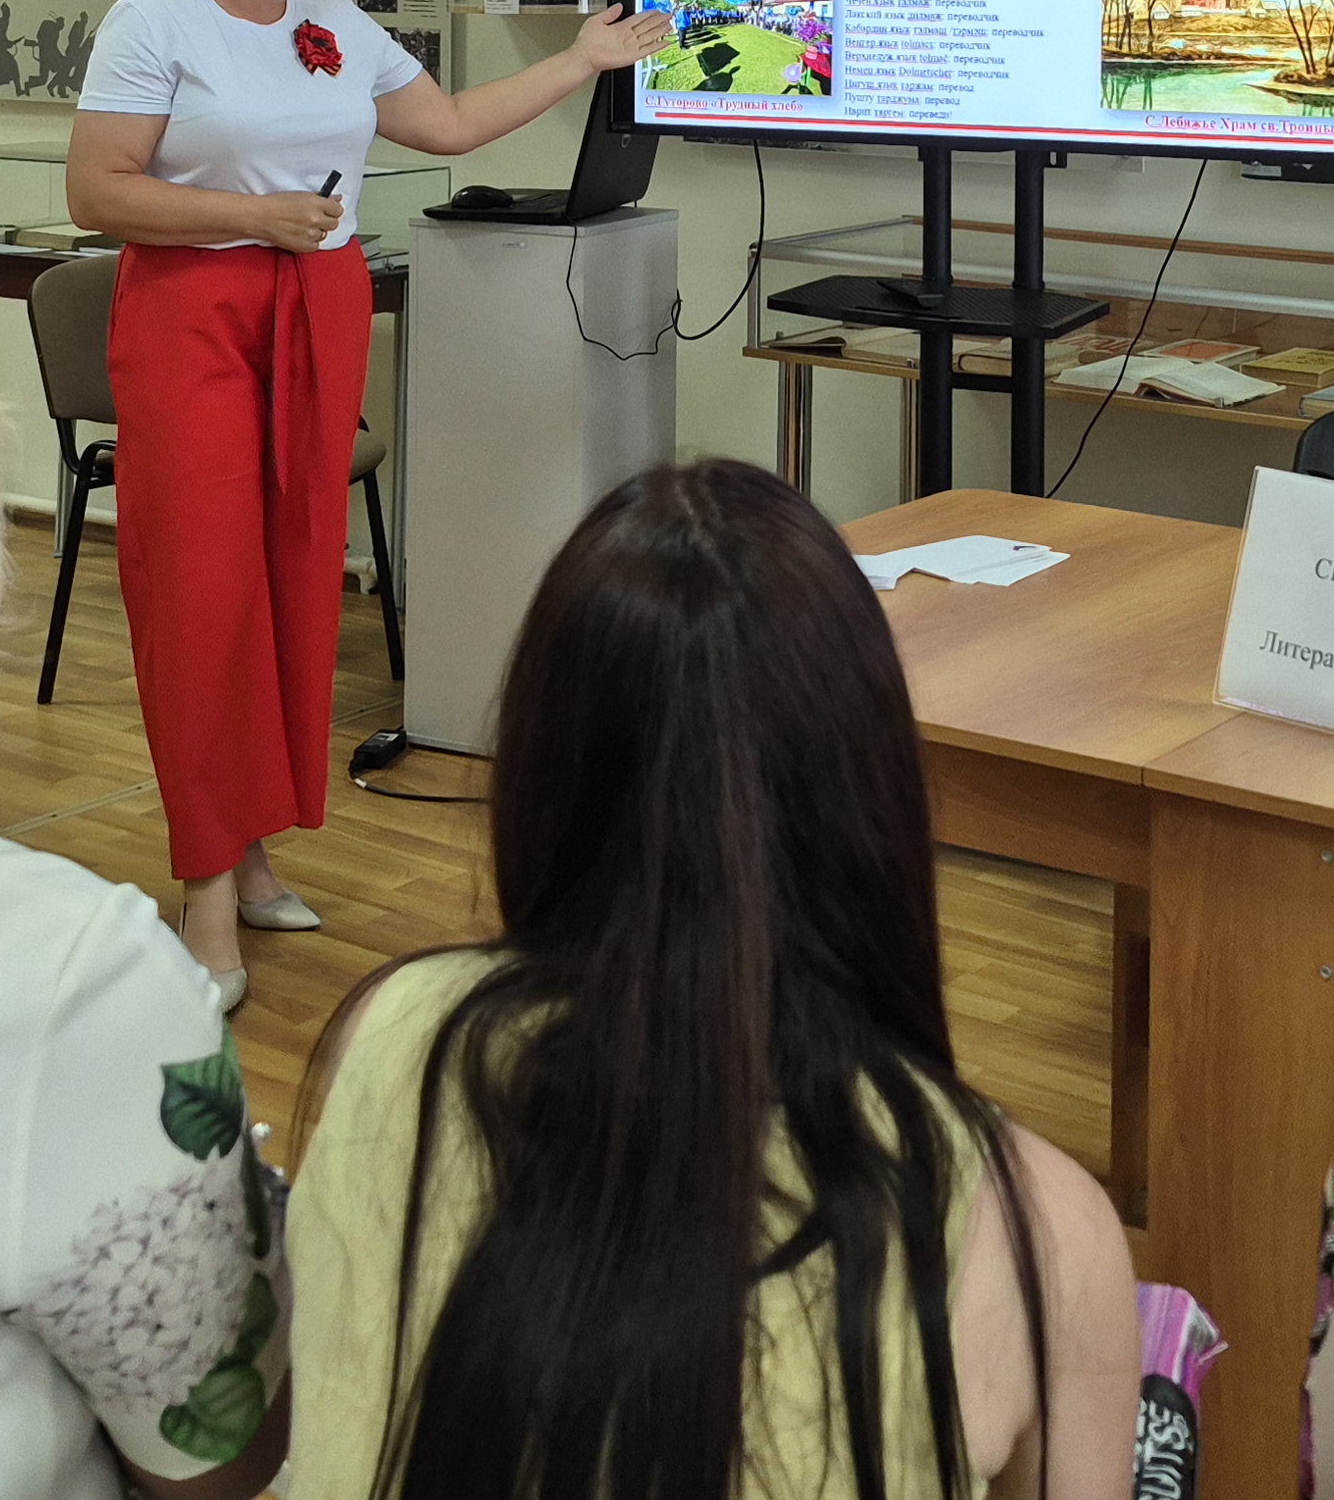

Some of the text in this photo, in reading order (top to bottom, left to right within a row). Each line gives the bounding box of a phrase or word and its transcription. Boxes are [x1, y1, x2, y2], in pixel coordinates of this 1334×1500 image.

[935, 0, 987, 10] переводчик
[845, 9, 882, 20] Лакский
[884, 12, 906, 20] язык
[947, 13, 1000, 24] переводчик
[991, 28, 1045, 39] переводчик
[939, 41, 991, 53] переводчик
[953, 55, 1006, 67] переводчик
[957, 69, 1010, 81] переводчик
[938, 83, 975, 94] перевод
[711, 97, 768, 112] «Трудный
[771, 100, 804, 112] хлеб»
[844, 92, 874, 104] Пушту
[924, 96, 960, 107] перевод
[1220, 117, 1256, 131] Храм
